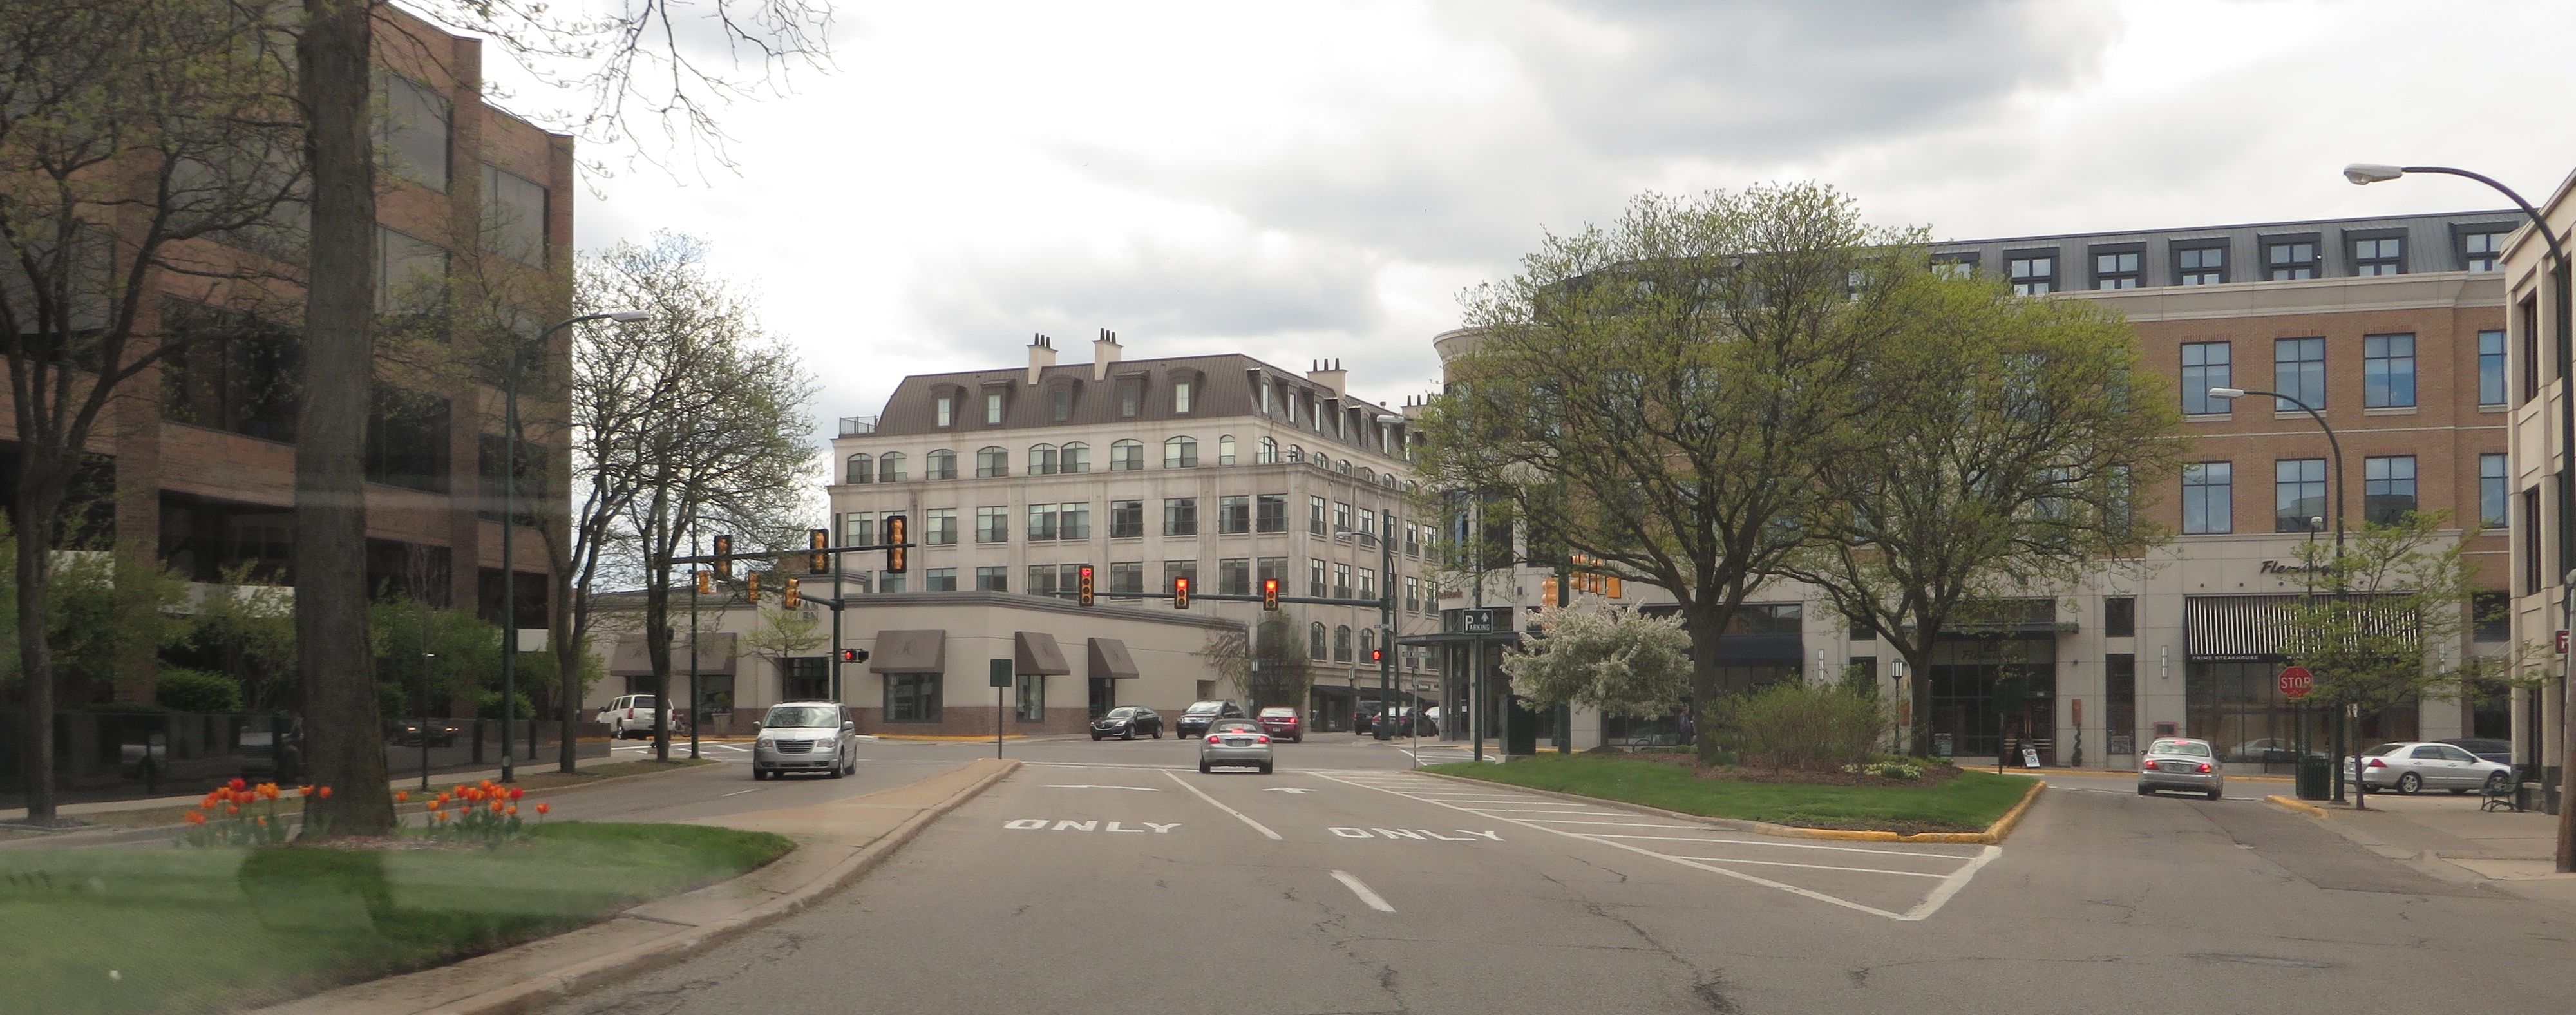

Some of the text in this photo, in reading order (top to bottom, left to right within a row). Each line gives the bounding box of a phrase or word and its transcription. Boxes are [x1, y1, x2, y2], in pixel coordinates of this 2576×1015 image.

[1465, 615, 1490, 631] PARKING
[2280, 676, 2311, 690] STOP
[1003, 819, 1183, 833] ONLY
[1327, 826, 1506, 842] ONLY
